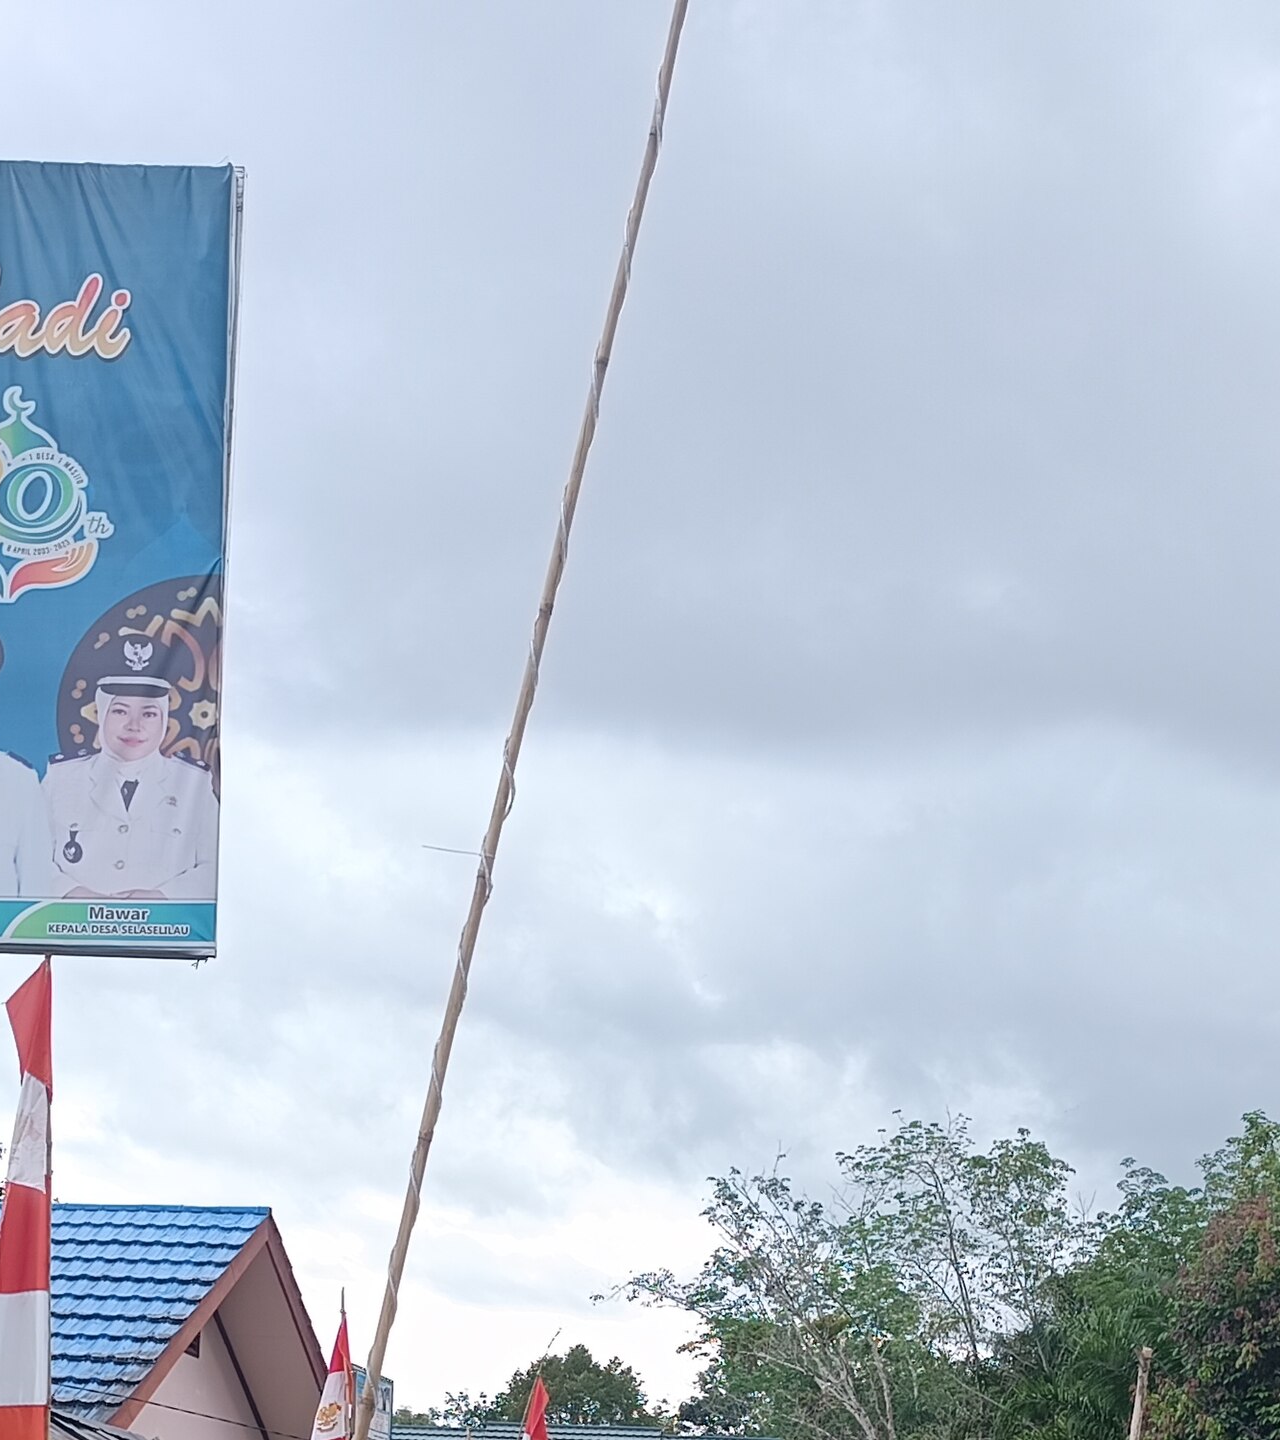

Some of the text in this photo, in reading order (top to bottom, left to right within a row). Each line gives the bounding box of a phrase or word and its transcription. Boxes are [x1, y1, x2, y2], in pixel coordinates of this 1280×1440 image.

[89, 907, 149, 921] Mawar
[48, 924, 189, 936] KEPALA DESA SELASELILAU
